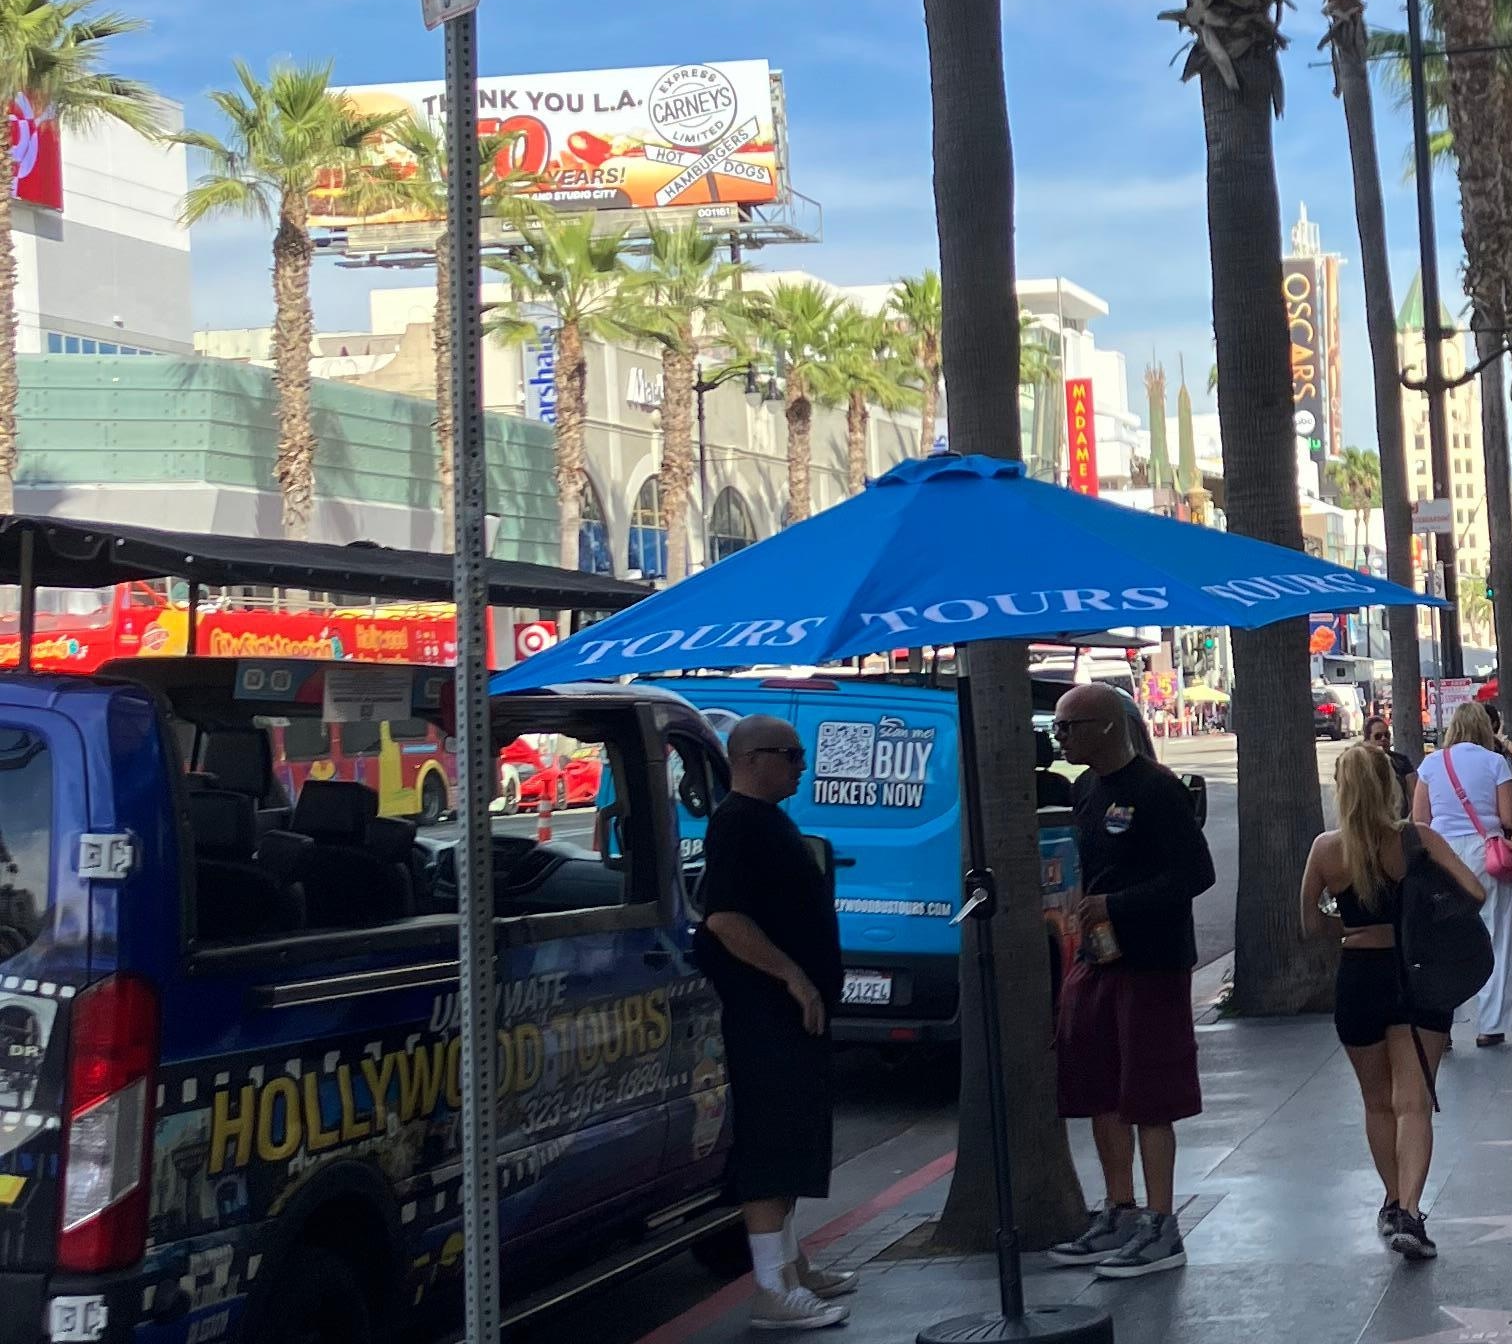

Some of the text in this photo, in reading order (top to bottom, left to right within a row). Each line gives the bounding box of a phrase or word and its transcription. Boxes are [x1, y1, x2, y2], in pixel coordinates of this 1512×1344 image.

[658, 67, 718, 94] EXPRESS
[422, 89, 643, 116] THNK YOU L.A.
[652, 86, 732, 125] CARNEYS
[672, 119, 725, 144] LIMITED
[547, 166, 627, 185] YEARS!
[656, 147, 767, 181] HOT DOGS
[664, 128, 750, 199] HAMBURGERS
[554, 190, 592, 201] STUDIO
[592, 188, 618, 200] CITY
[1283, 272, 1317, 401] OSCARS
[1072, 383, 1090, 477] MADAME
[1202, 572, 1377, 607] TOURS
[860, 586, 1169, 635] TOURS
[575, 616, 828, 667] TOURS
[873, 741, 934, 781] BUY
[813, 779, 924, 807] TICKETS NOW
[429, 971, 568, 1033] ULIMATE
[549, 987, 671, 1076] TOURS
